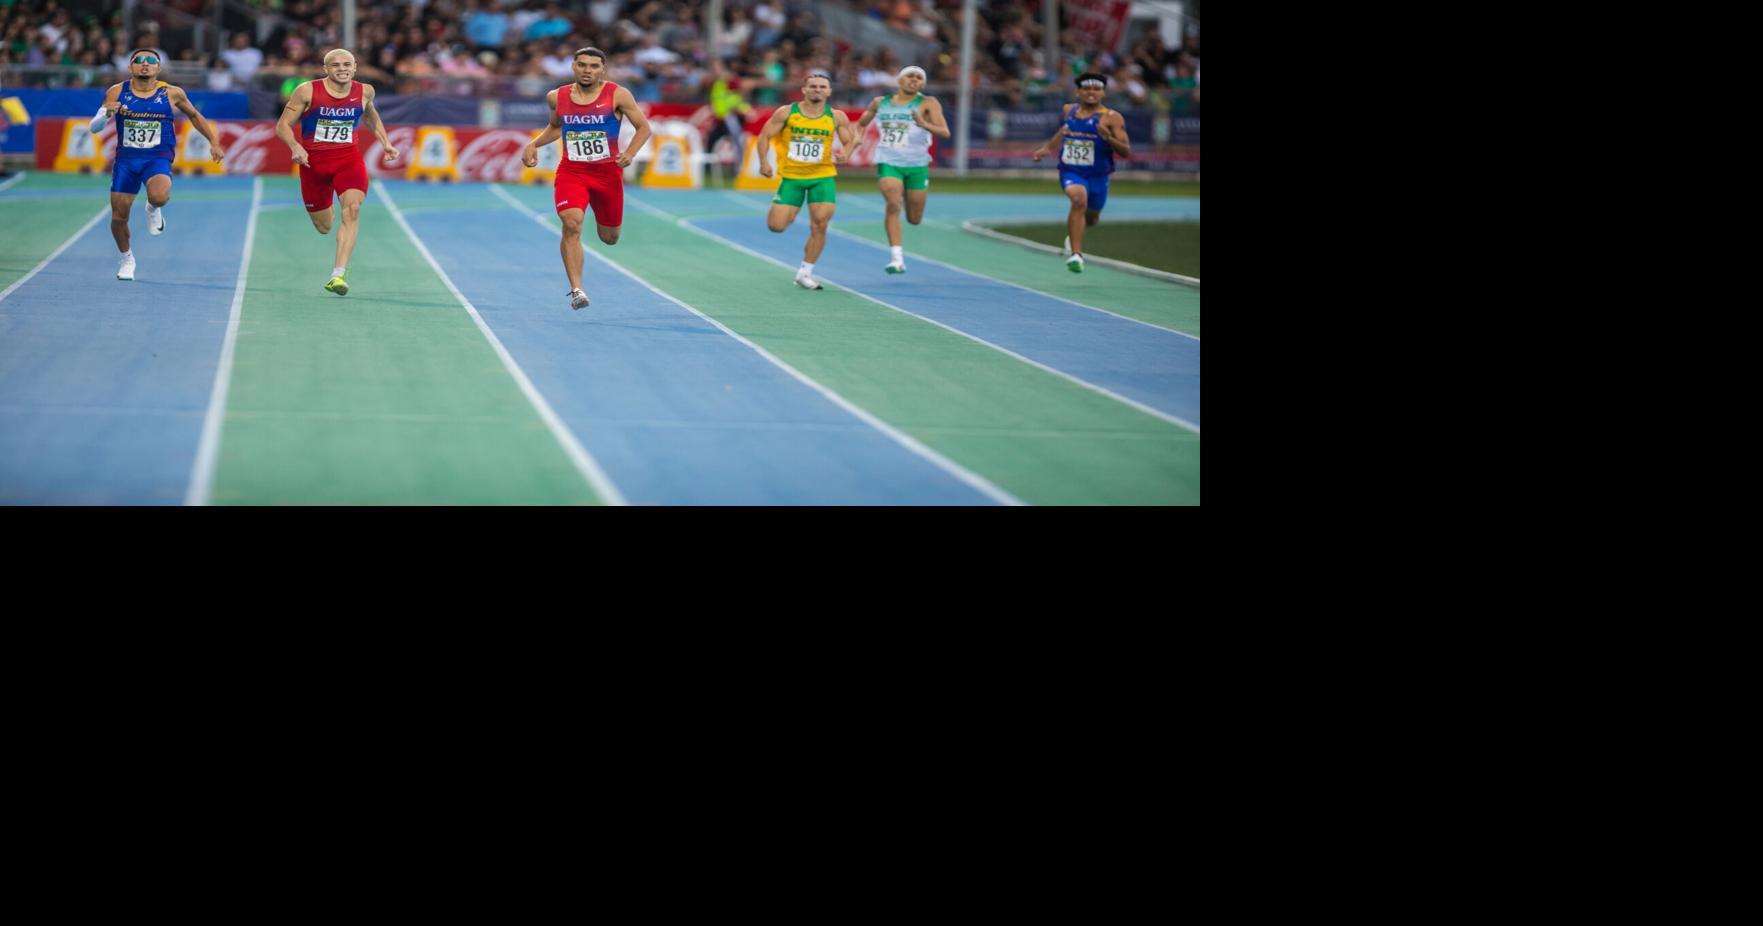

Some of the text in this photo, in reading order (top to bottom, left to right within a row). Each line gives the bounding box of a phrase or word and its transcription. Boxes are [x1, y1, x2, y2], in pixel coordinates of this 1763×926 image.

[319, 106, 355, 117] UAGM
[563, 114, 606, 124] UAGM
[128, 128, 156, 143] 337
[322, 126, 349, 141] 179
[790, 125, 830, 137] INTER
[572, 139, 604, 156] 186
[795, 143, 820, 158] 108
[1066, 146, 1089, 160] 352
